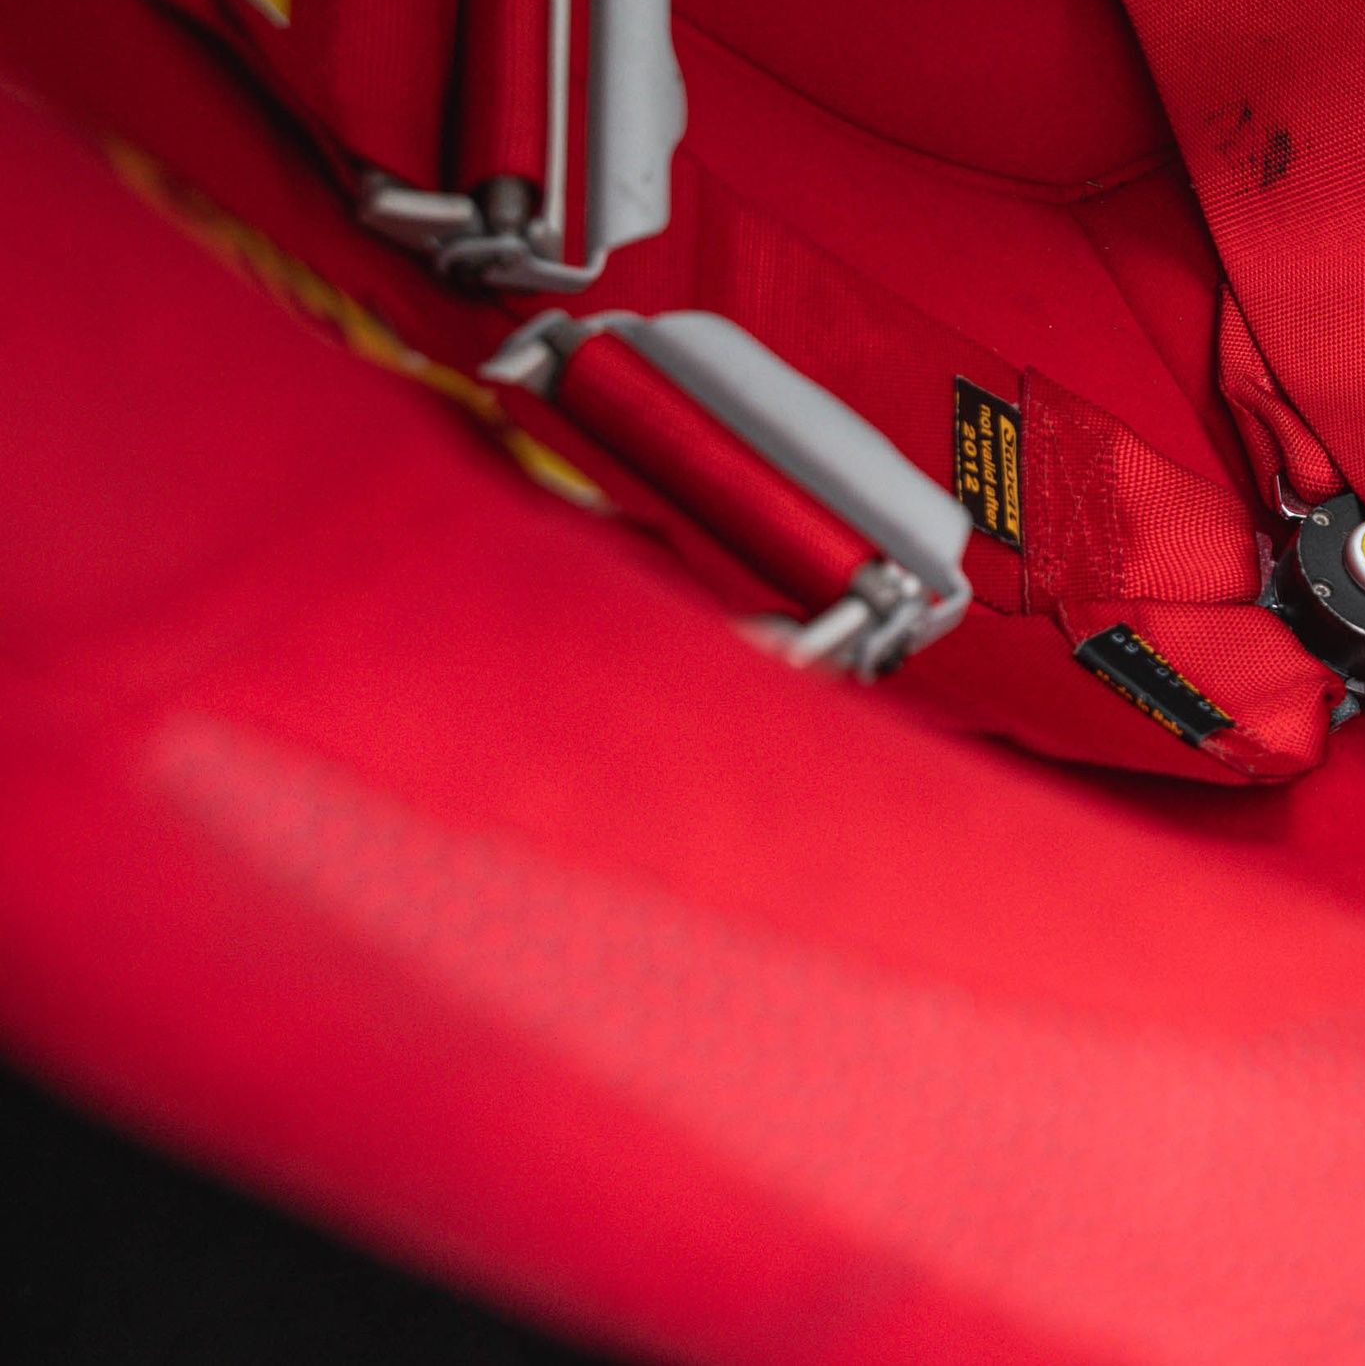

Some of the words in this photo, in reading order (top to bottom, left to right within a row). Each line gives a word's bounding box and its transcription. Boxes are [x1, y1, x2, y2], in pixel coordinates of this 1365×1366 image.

[978, 403, 993, 436] not
[962, 420, 979, 493] 2012
[981, 438, 996, 483] valid
[985, 484, 996, 529] after
